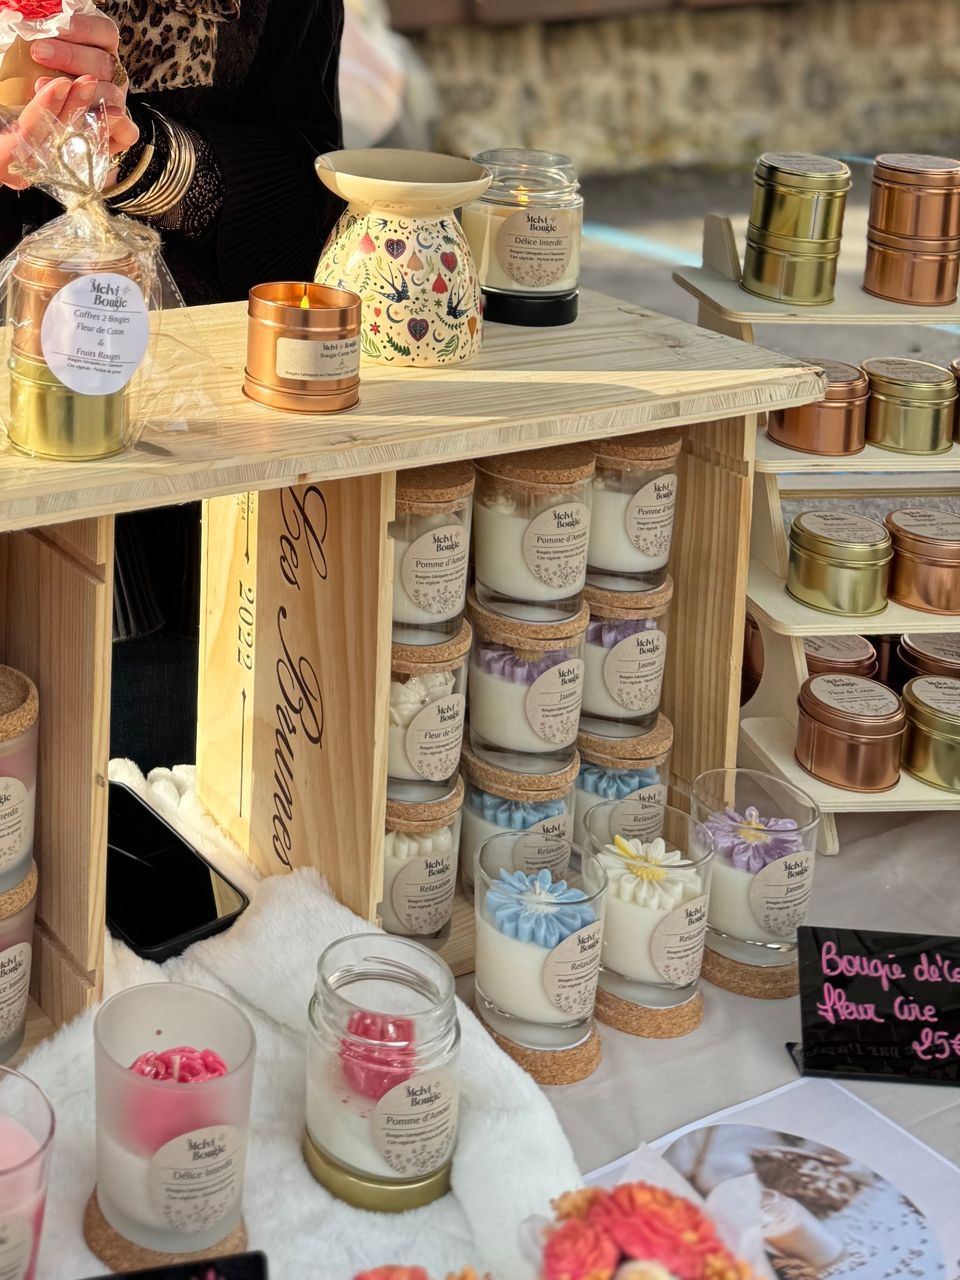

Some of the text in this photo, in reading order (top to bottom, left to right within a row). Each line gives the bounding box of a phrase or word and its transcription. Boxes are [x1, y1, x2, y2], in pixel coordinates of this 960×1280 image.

[515, 236, 563, 246] Délice Interdit
[90, 278, 120, 295] Melvi
[93, 294, 127, 310] Bougie
[74, 309, 130, 324] Coffret 2 Bougies
[77, 322, 124, 335] Fleur de Coton
[76, 347, 120, 361] Fruits Rouges
[238, 580, 256, 671] 2022
[272, 485, 328, 873] Les Brunes
[821, 940, 906, 991] Bougie
[816, 982, 885, 1024] fleur
[386, 1116, 420, 1125] Pomme
[173, 1171, 202, 1180] Délice
